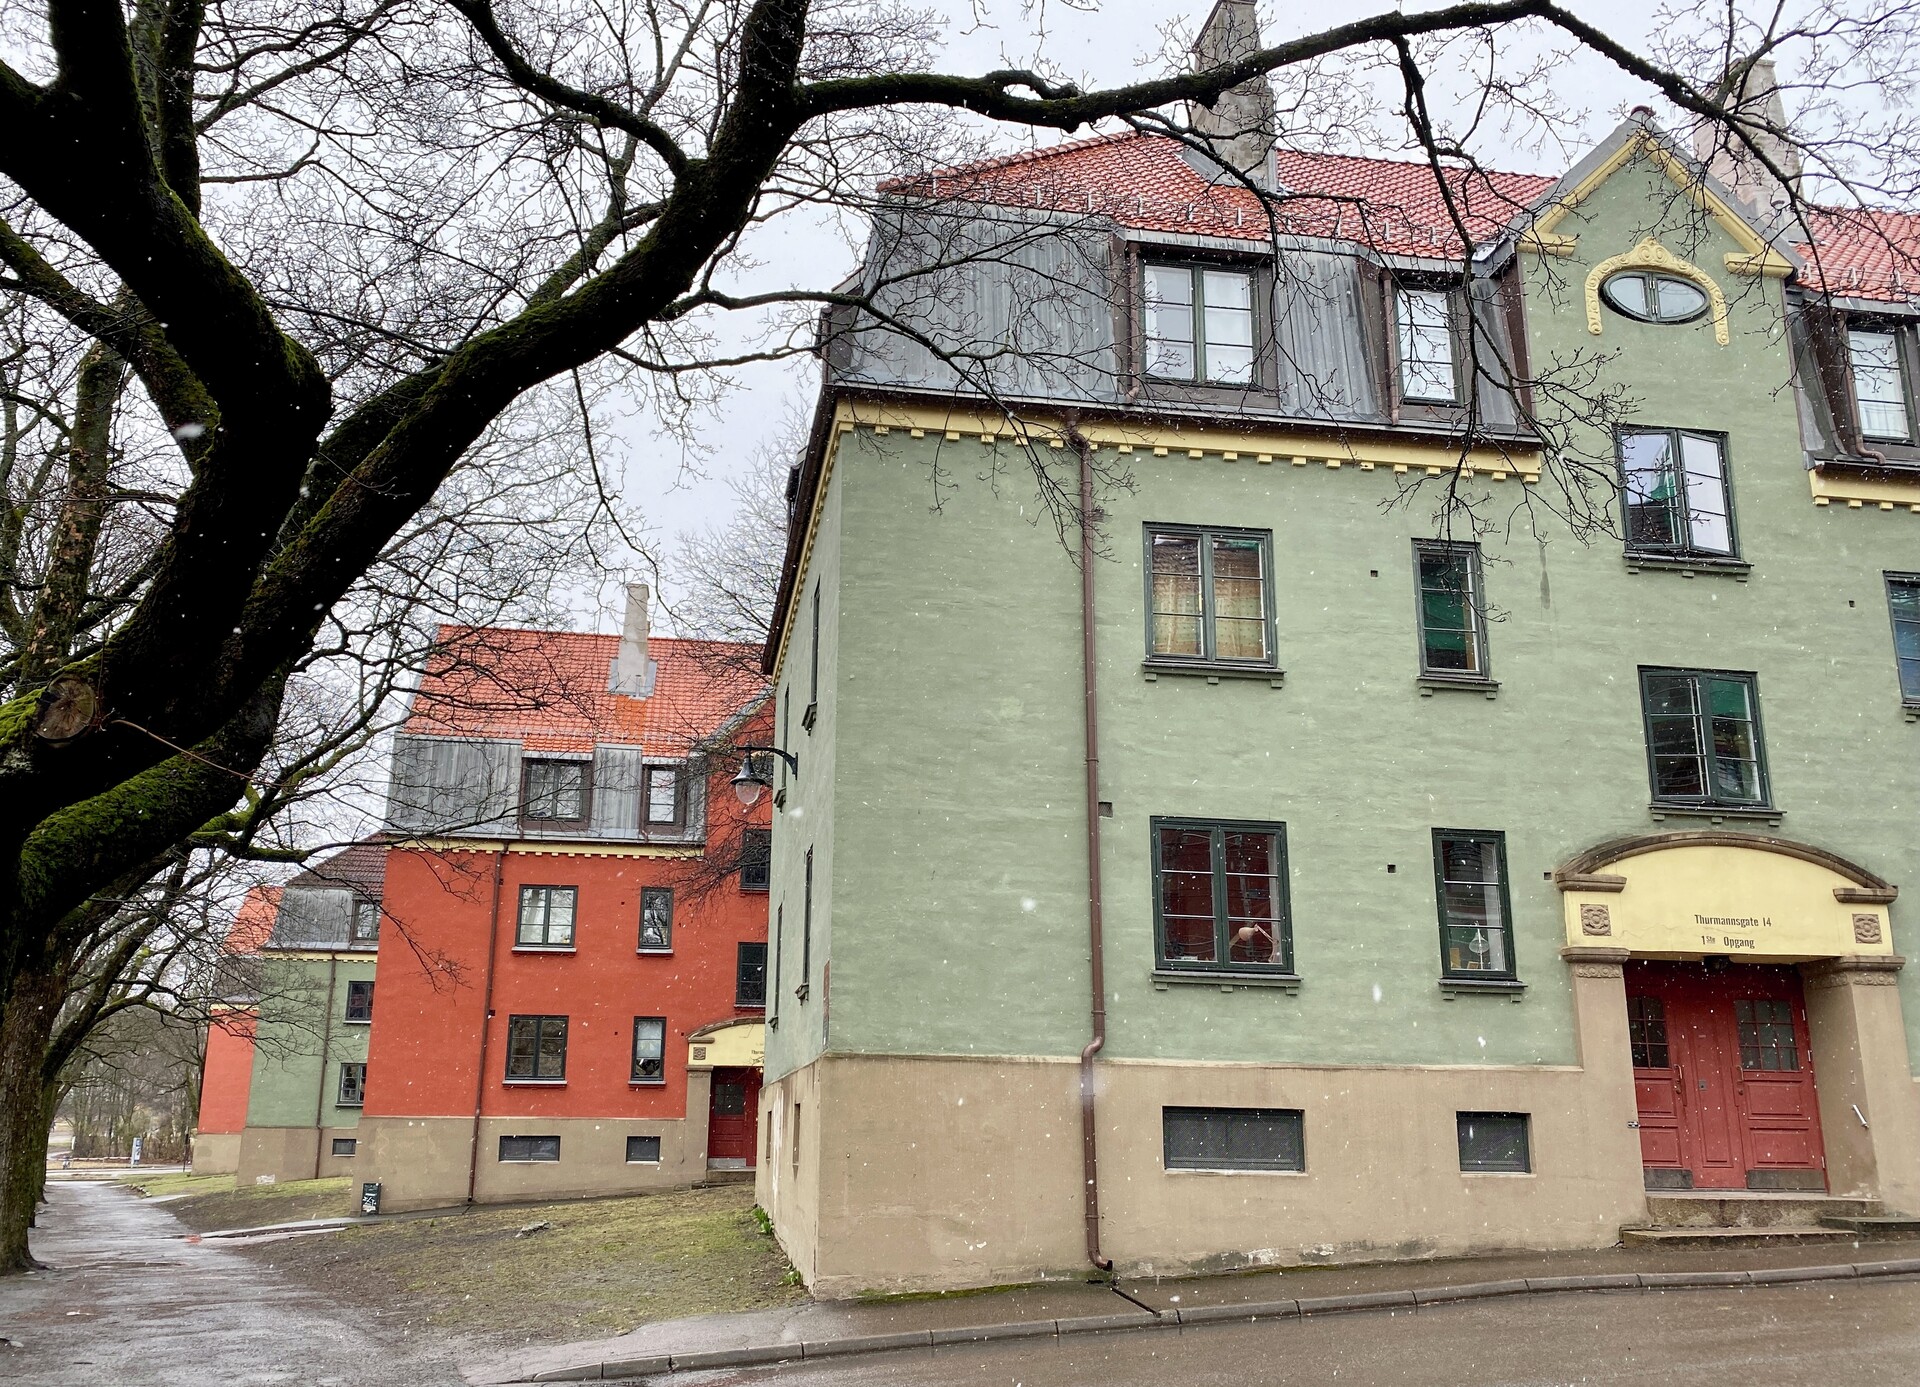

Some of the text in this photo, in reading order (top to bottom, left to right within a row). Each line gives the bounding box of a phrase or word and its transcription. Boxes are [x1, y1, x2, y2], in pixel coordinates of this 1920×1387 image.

[1694, 914, 1772, 928] Thurmannsgate 14
[1723, 936, 1755, 949] Opgang
